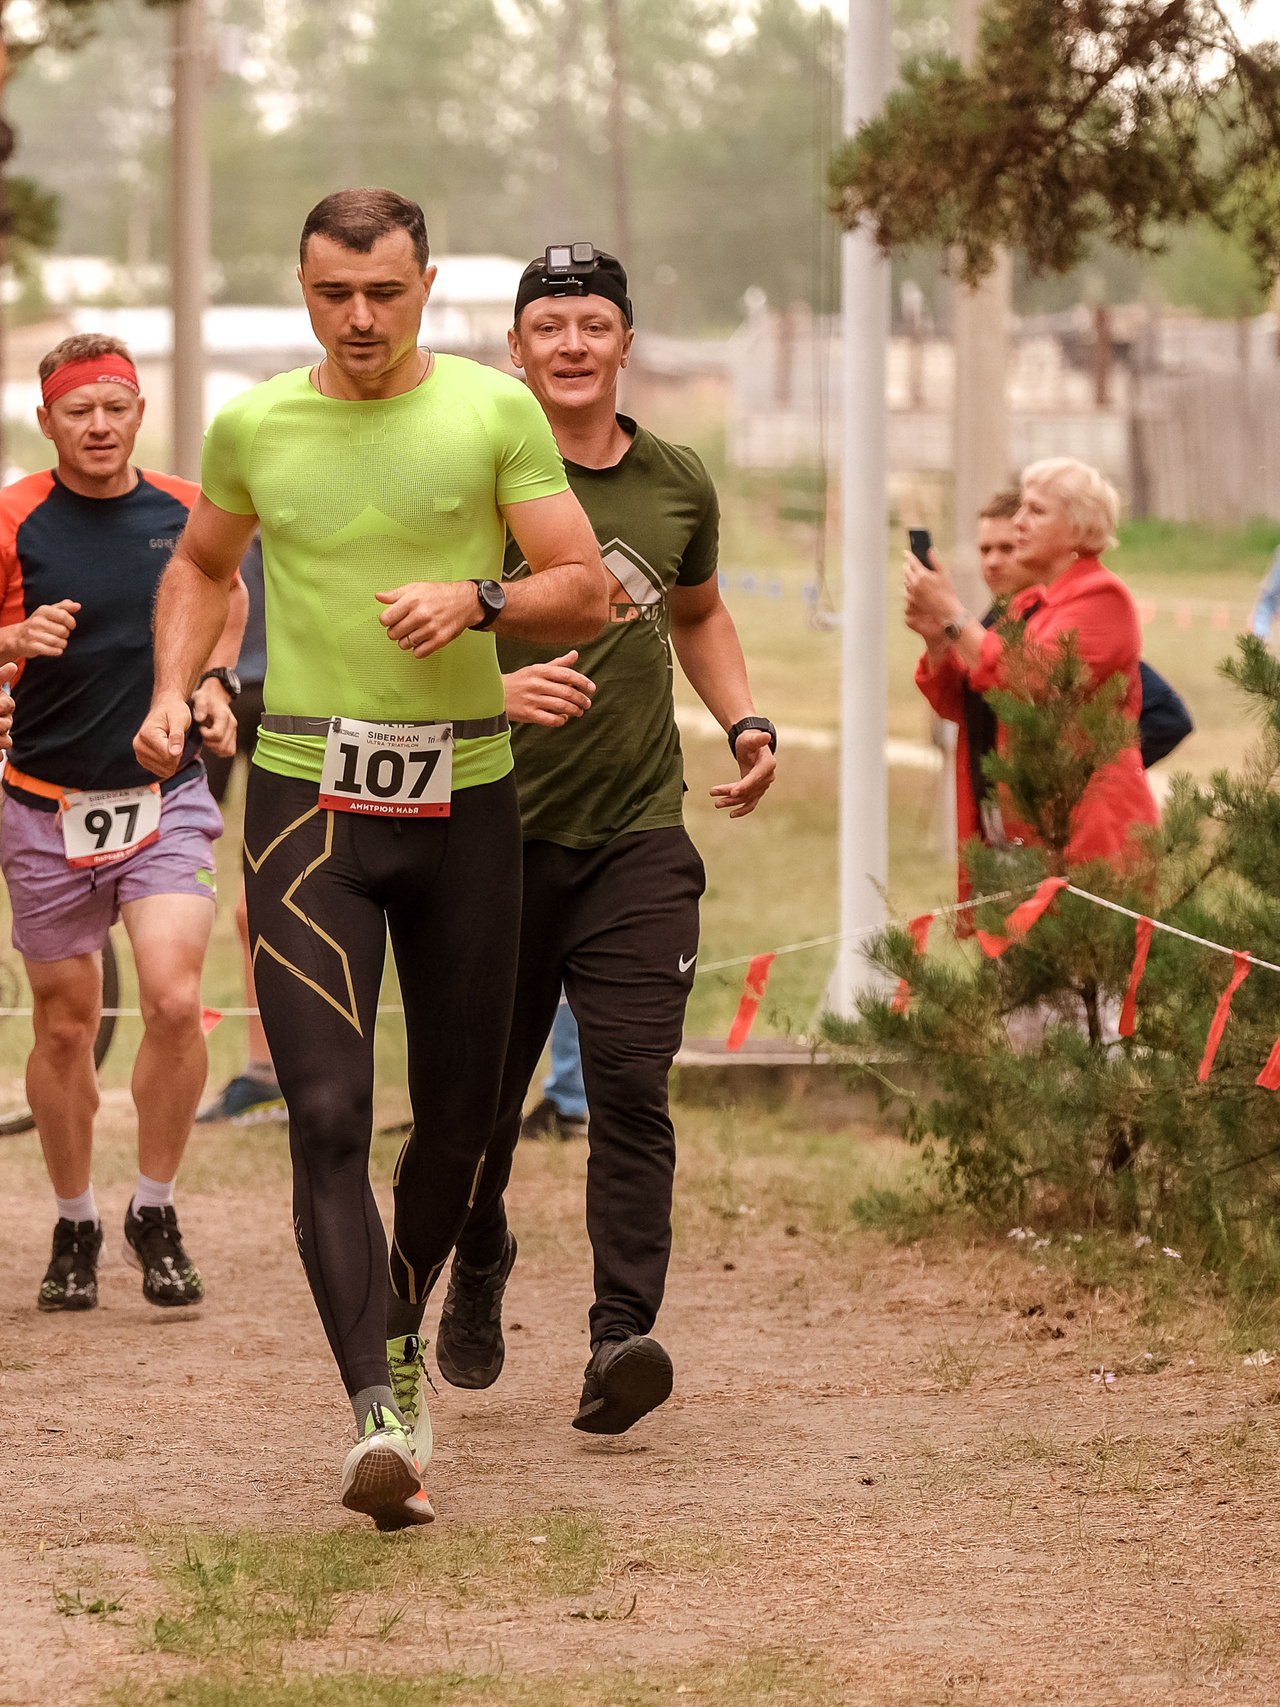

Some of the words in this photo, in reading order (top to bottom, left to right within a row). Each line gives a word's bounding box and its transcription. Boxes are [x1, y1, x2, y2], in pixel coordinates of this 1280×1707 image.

[367, 731, 420, 743] SIBERMAN
[334, 742, 441, 799] 107
[349, 802, 394, 813] ДМИТРЮК
[85, 803, 140, 849] 97
